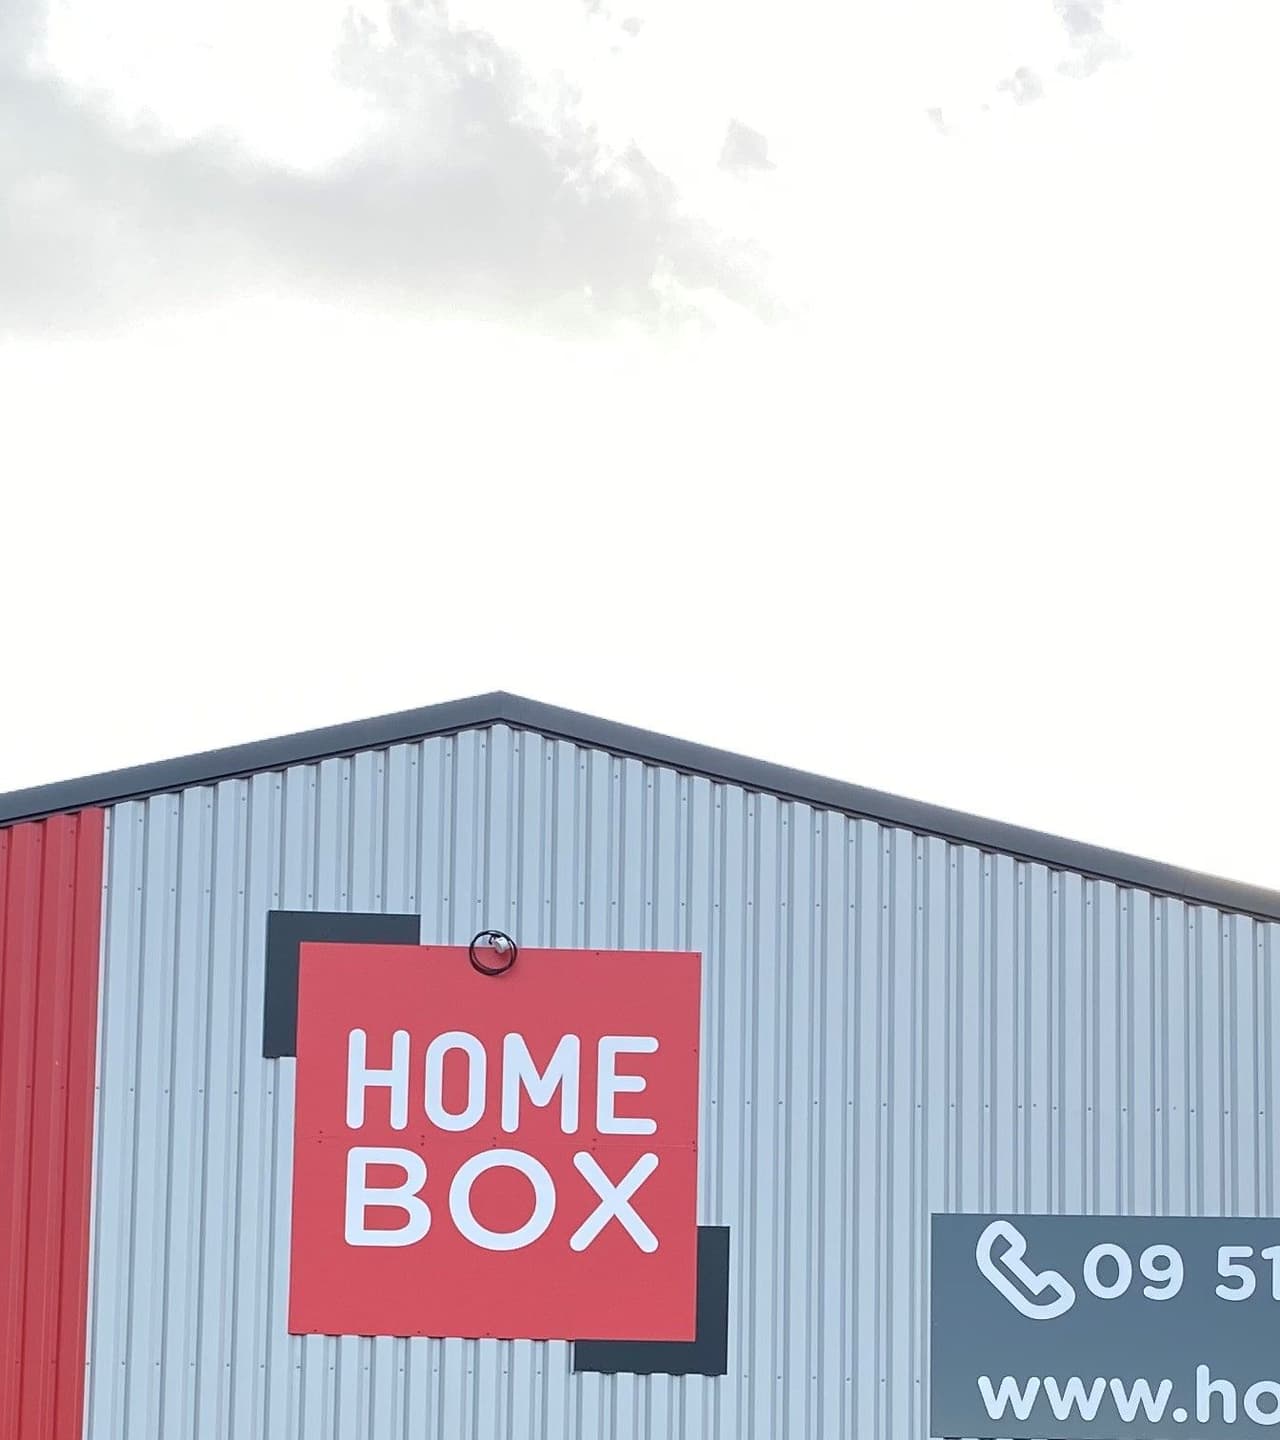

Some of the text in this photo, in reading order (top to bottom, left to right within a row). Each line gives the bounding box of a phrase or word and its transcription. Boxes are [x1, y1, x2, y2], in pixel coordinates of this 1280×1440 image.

[345, 1027, 660, 1136] HOME
[343, 1145, 660, 1254] BOX
[1082, 1242, 1185, 1302] 09
